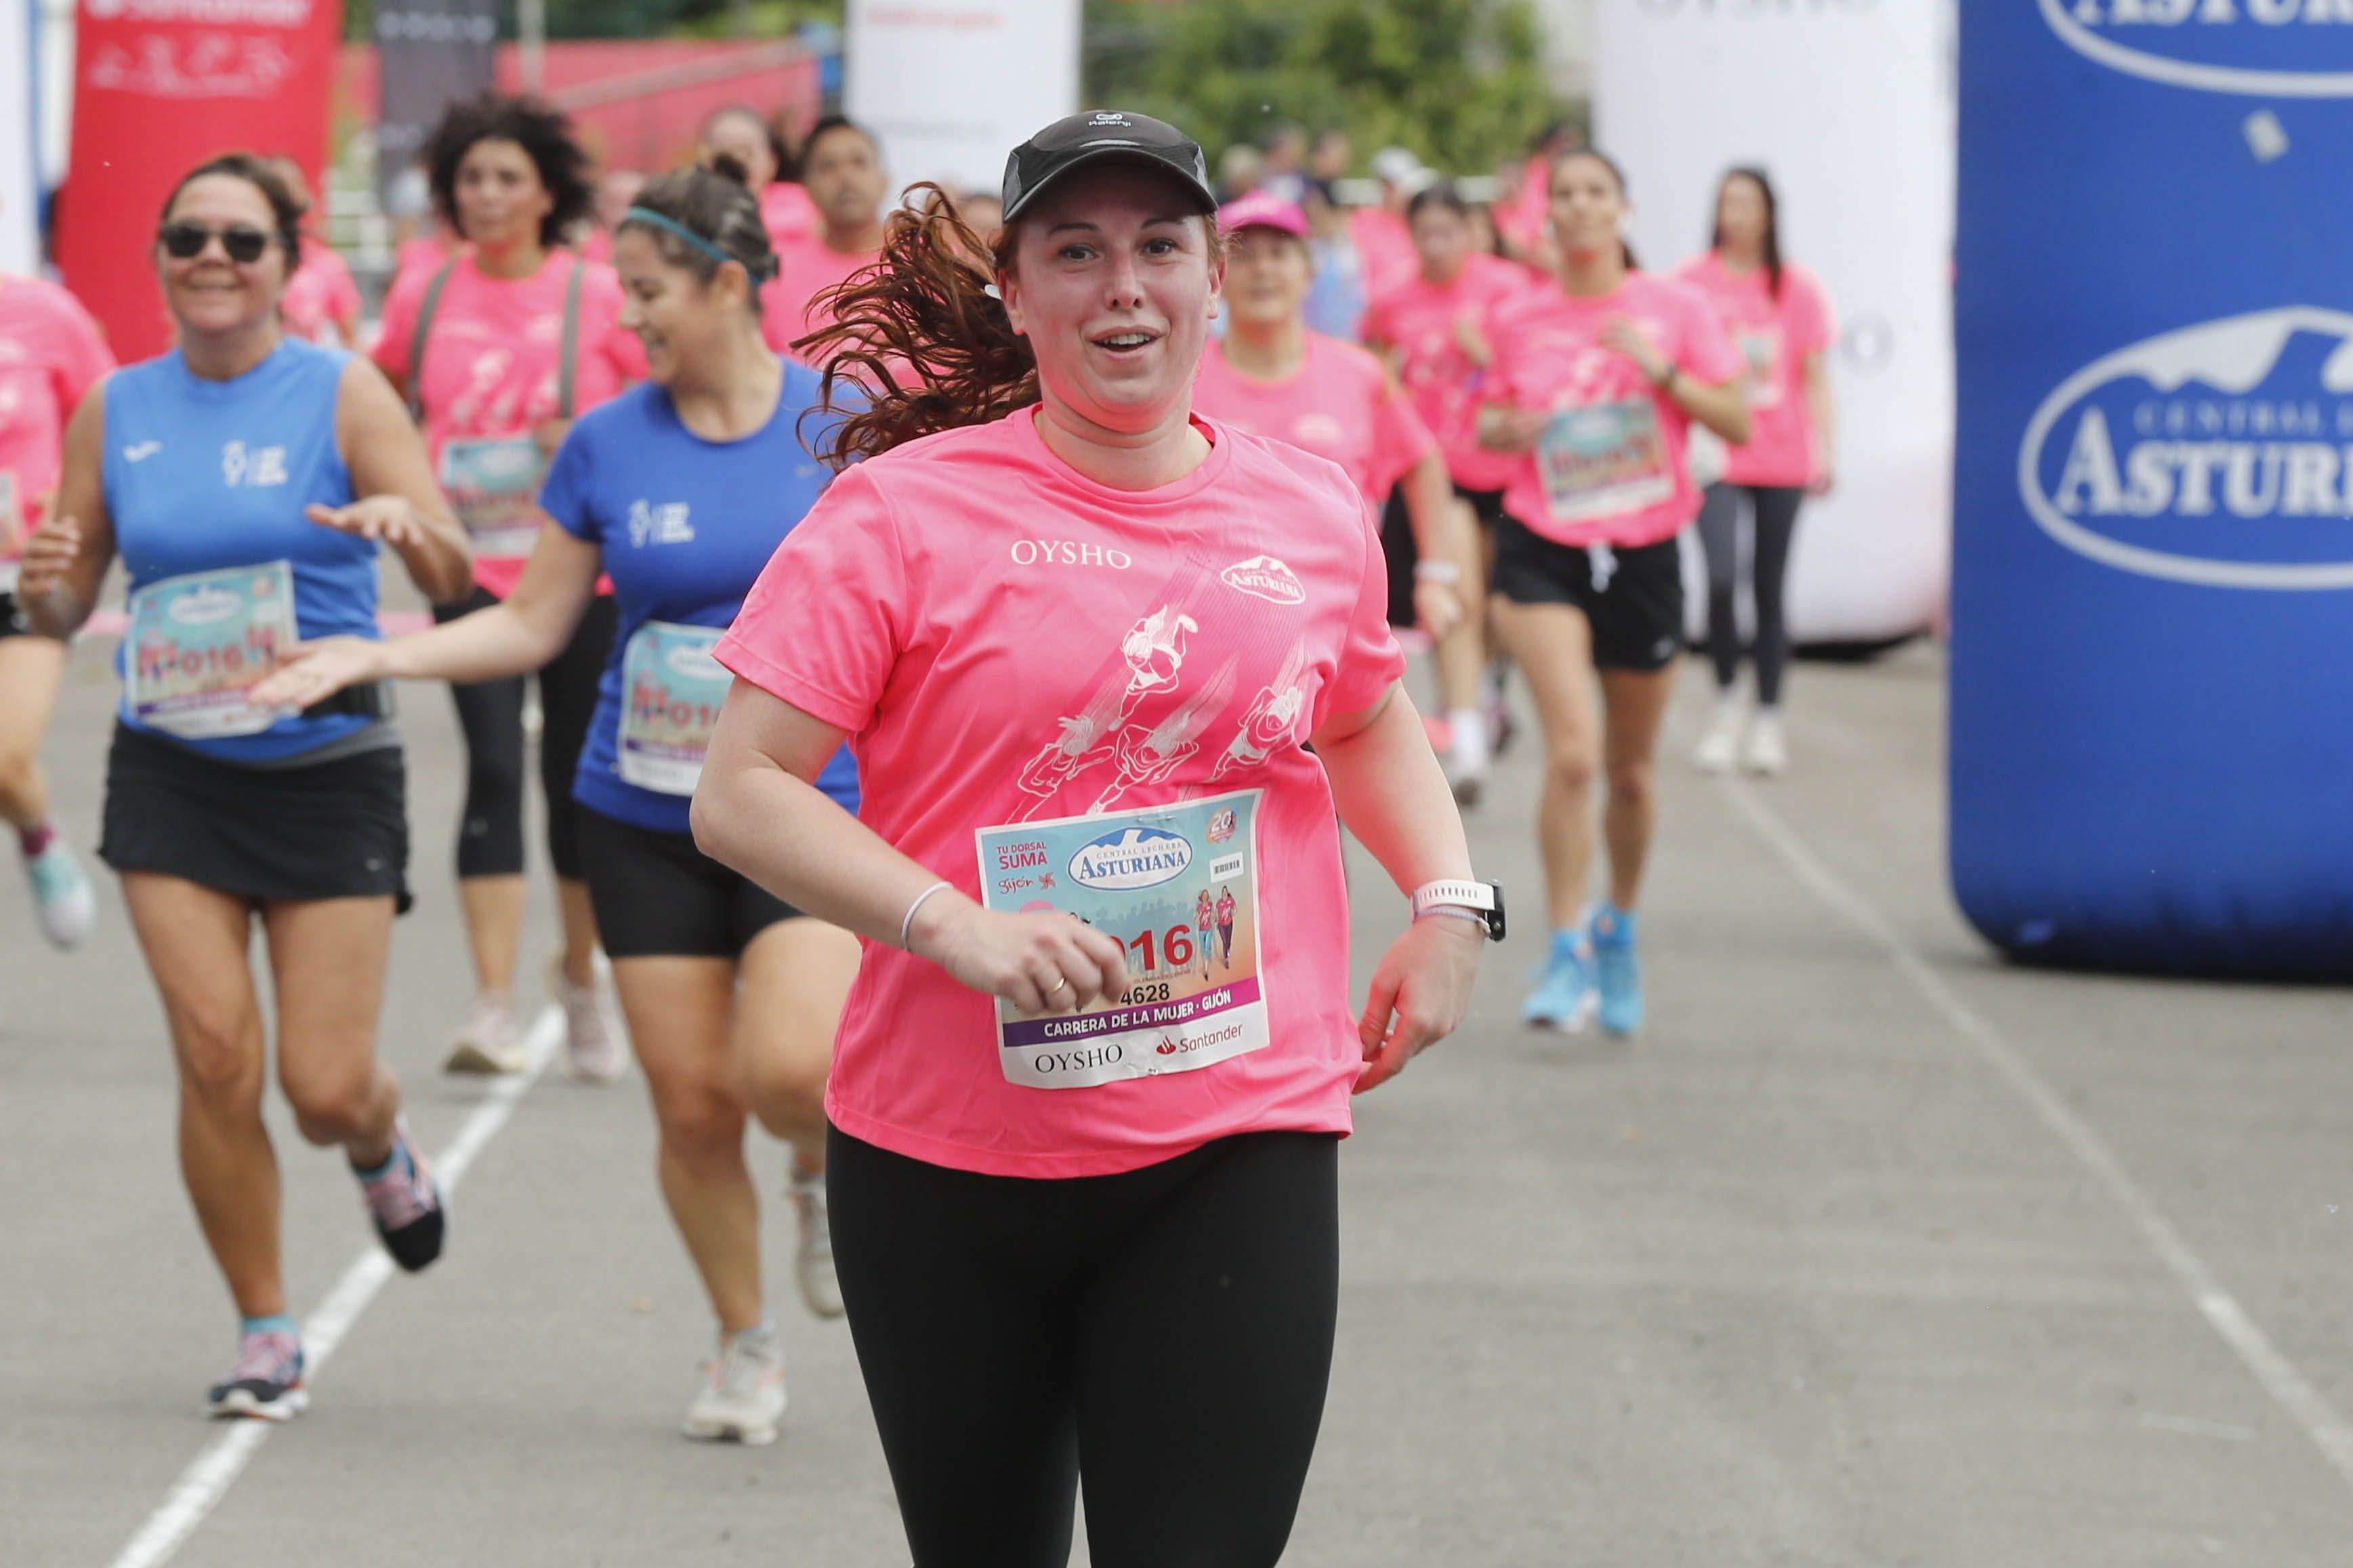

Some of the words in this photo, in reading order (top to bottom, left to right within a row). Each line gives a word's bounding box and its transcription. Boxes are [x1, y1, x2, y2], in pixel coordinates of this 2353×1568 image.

[1011, 540, 1131, 570] OYSHO
[997, 845, 1008, 854] TU
[1011, 841, 1047, 853] DORSAL
[999, 851, 1048, 870] SUMA
[1096, 848, 1138, 860] CENTRAL
[1142, 841, 1182, 854] LECHERA
[1079, 851, 1186, 880] ASTURIANA
[998, 875, 1035, 895] gijón
[1108, 924, 1193, 971] 16
[1043, 1017, 1107, 1037] CARRERA
[1111, 1013, 1129, 1029] DE
[1133, 1009, 1150, 1025] LA
[1154, 1002, 1194, 1022] MUJER
[1201, 988, 1232, 1011] GIJÓN
[1035, 1044, 1123, 1074] OYSHO
[1179, 1023, 1244, 1053] Santander
